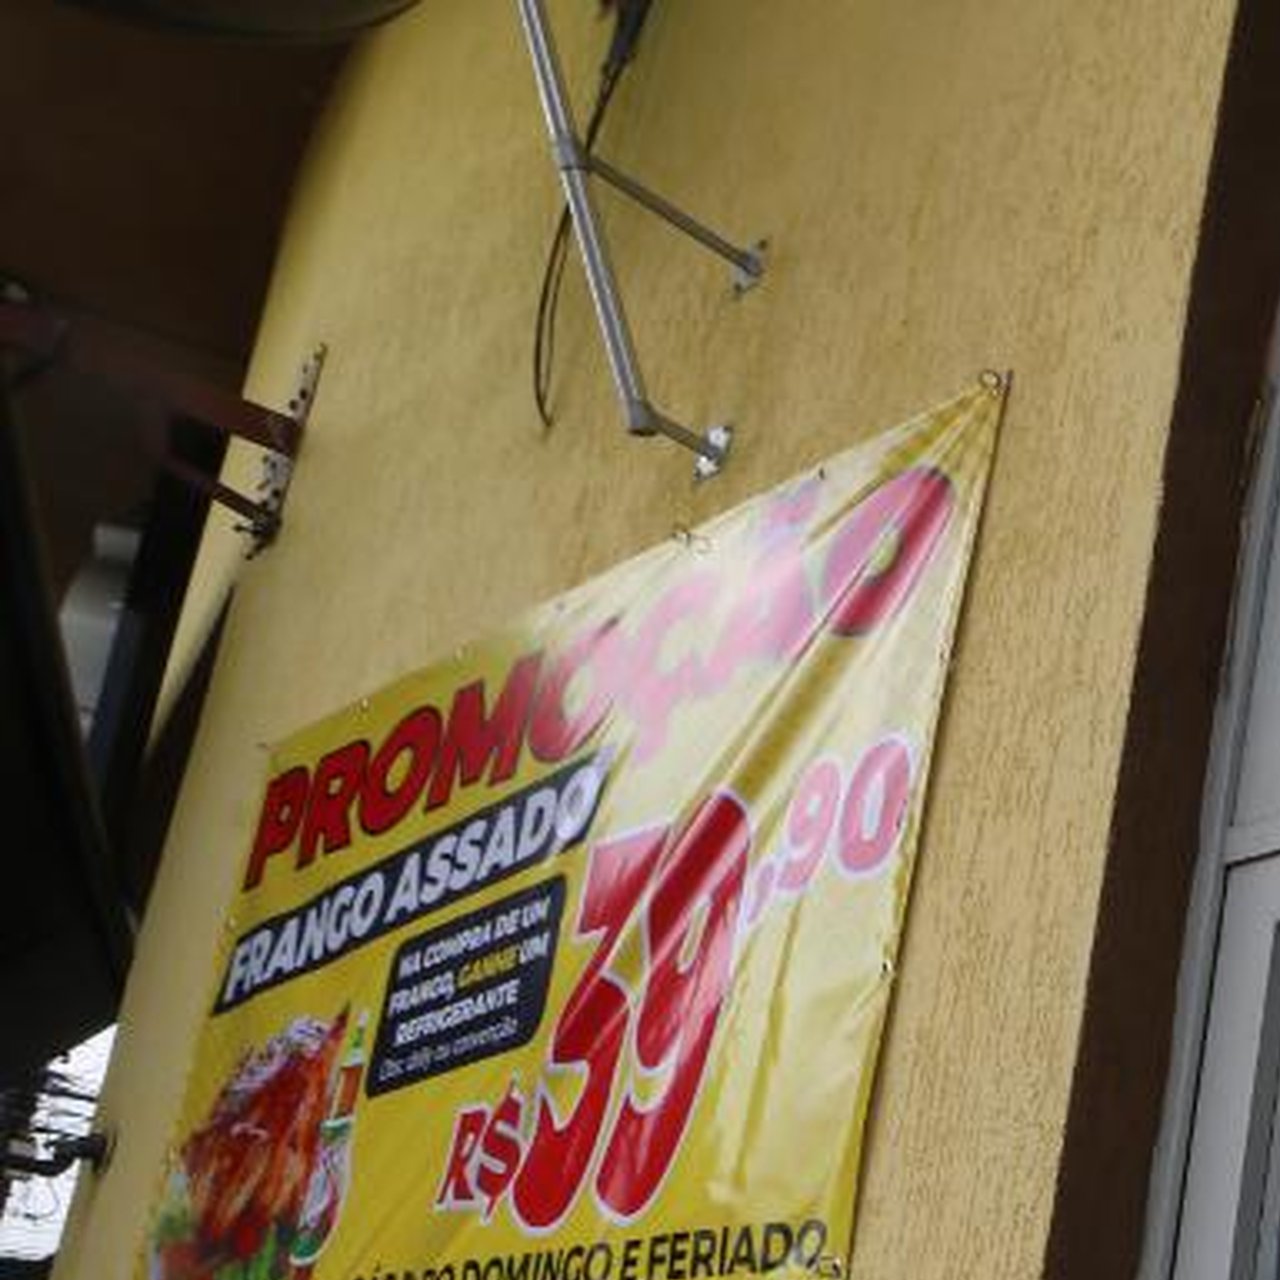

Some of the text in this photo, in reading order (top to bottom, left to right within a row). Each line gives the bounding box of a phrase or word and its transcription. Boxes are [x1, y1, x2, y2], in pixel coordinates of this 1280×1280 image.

[224, 742, 613, 1000] FRANGO ASSADO
[423, 922, 492, 968] COMPRA
[519, 931, 551, 964] UM
[394, 979, 521, 1046] REFRIGERANTE
